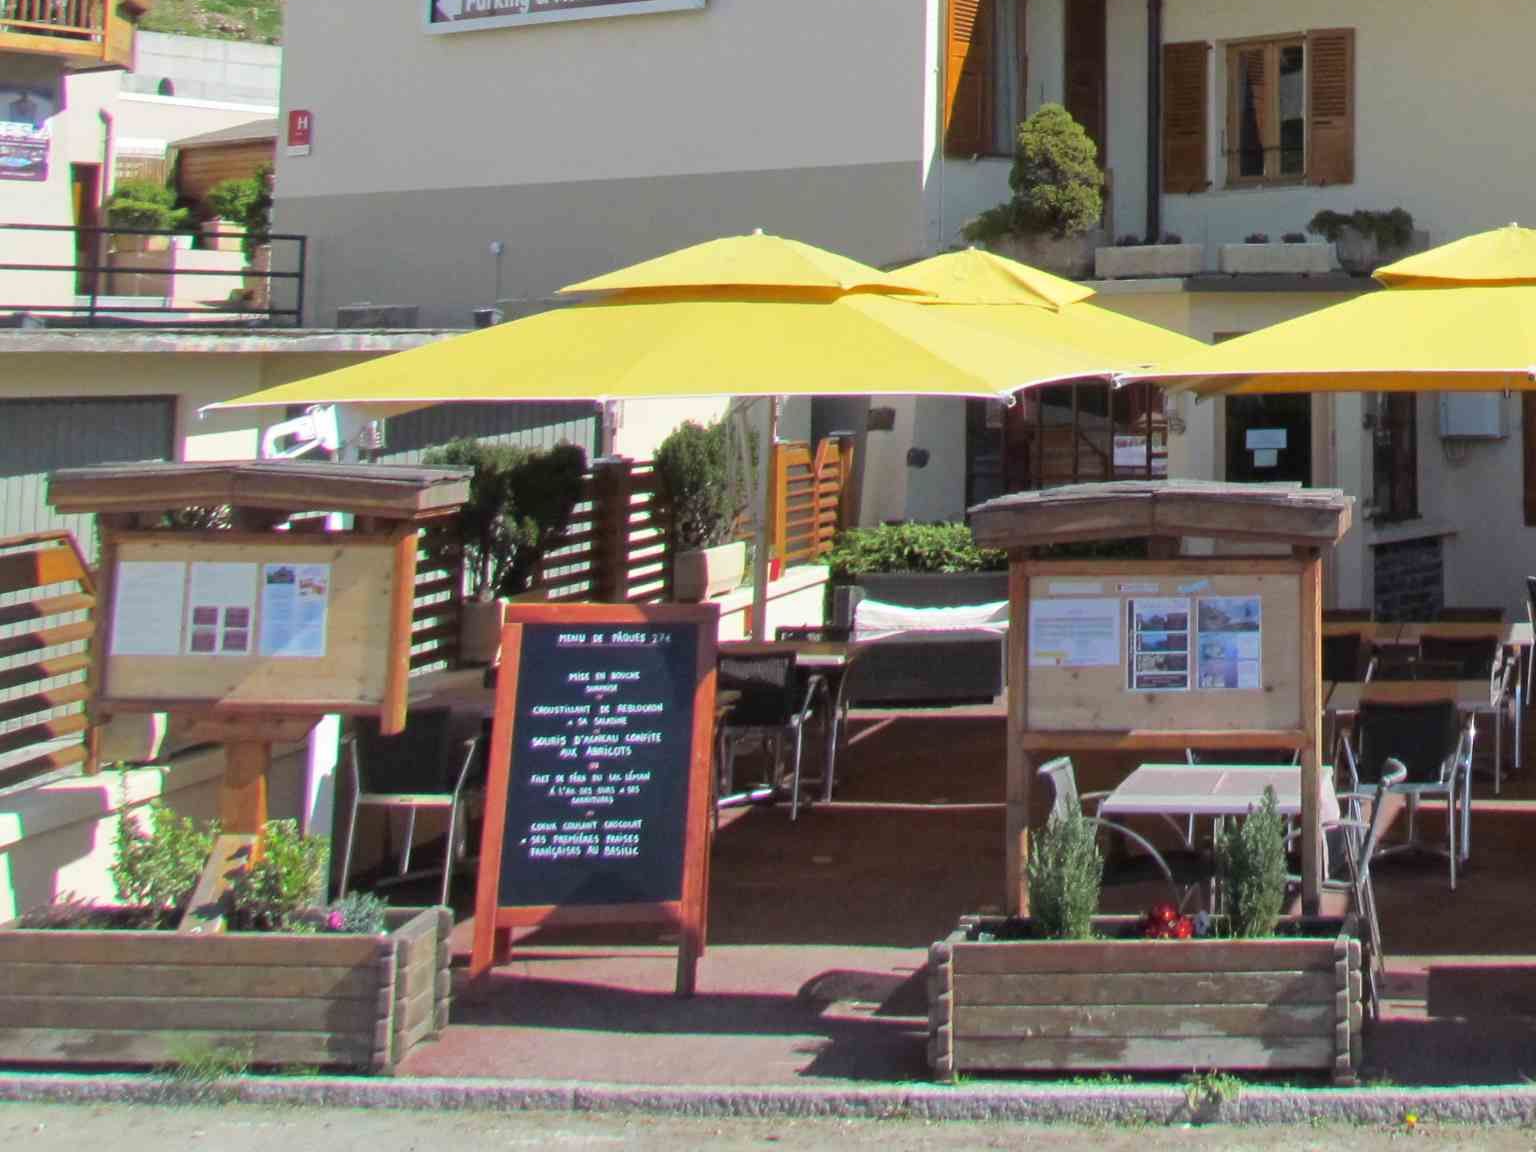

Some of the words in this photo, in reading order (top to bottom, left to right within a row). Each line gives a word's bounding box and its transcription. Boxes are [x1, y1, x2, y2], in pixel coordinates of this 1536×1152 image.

[297, 116, 309, 130] H
[558, 633, 586, 643] MENU
[592, 633, 604, 643] DE
[595, 672, 606, 681] EN
[600, 705, 610, 714] DE
[560, 748, 578, 758] AUX
[587, 846, 599, 856] AU
